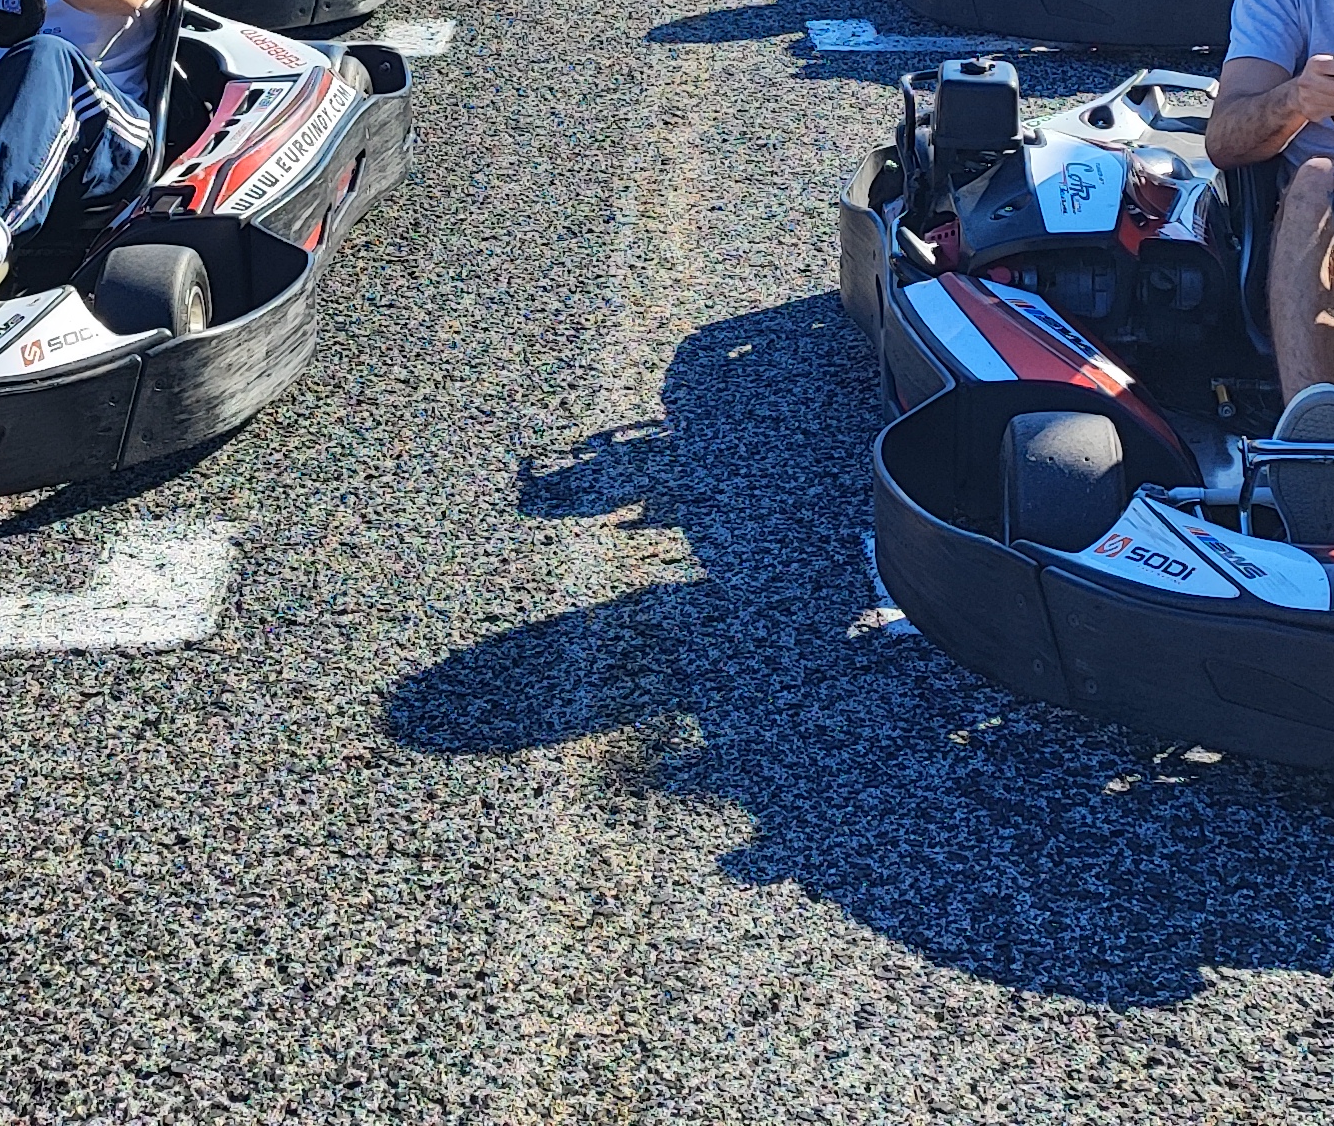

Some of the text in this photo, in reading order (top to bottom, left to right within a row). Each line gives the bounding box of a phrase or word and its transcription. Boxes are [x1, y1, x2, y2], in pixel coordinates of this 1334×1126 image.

[230, 83, 352, 213] WWW.EUROINDY.COM
[1124, 545, 1198, 581] SODI
[1207, 538, 1267, 581] SWS
